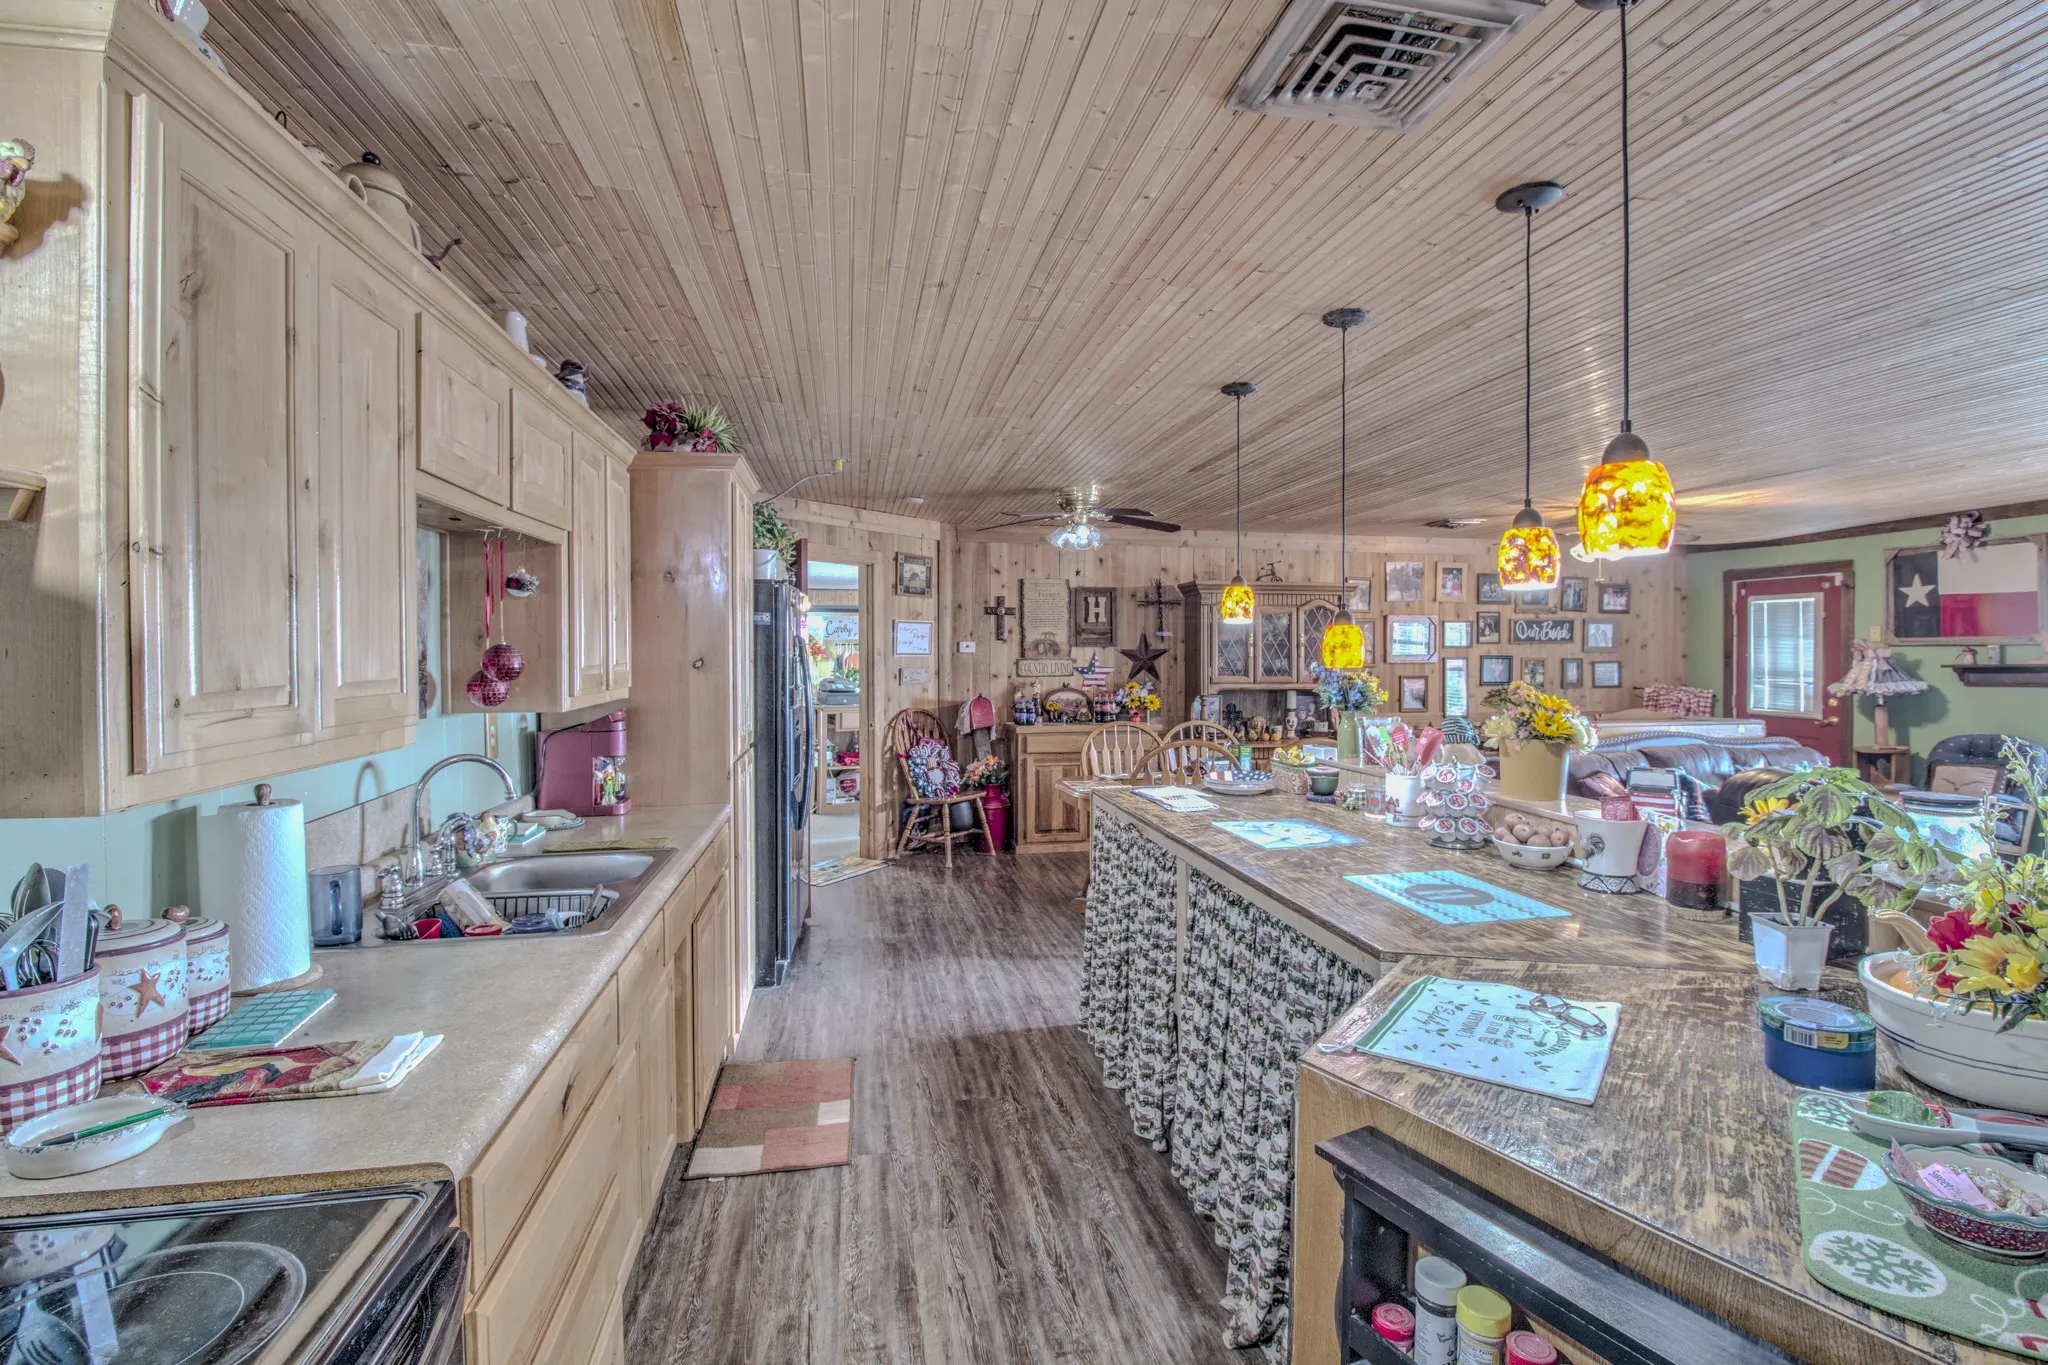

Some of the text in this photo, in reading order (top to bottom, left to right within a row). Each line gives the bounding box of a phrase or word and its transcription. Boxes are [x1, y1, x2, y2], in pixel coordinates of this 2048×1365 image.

[1087, 596, 1107, 623] H
[1516, 620, 1571, 640] Our Bunch
[1020, 662, 1072, 674] COUNTRY LIVING
